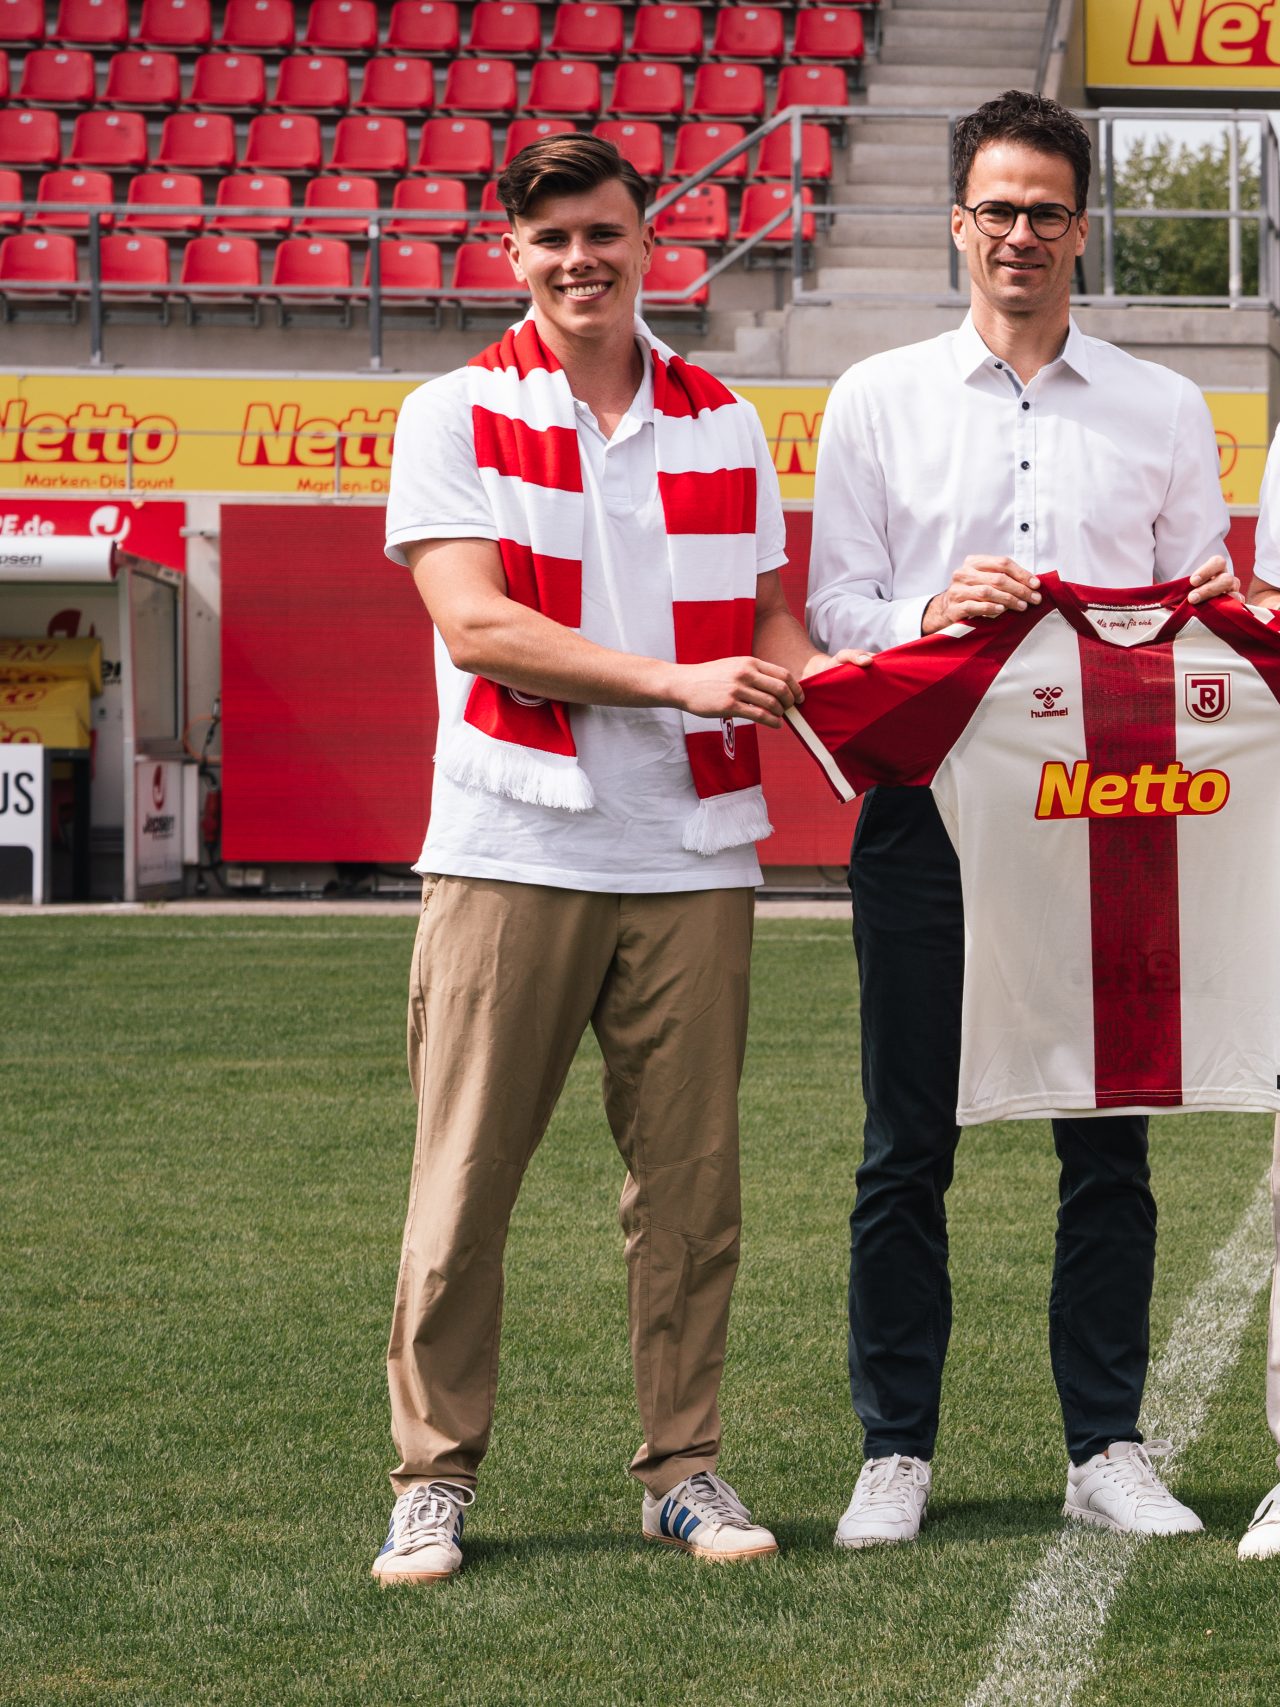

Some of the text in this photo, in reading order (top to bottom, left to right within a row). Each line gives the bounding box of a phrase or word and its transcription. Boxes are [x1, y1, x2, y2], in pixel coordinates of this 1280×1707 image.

[238, 403, 398, 468] Nett
[1031, 707, 1068, 718] hummel
[1035, 761, 1230, 820] Netto
